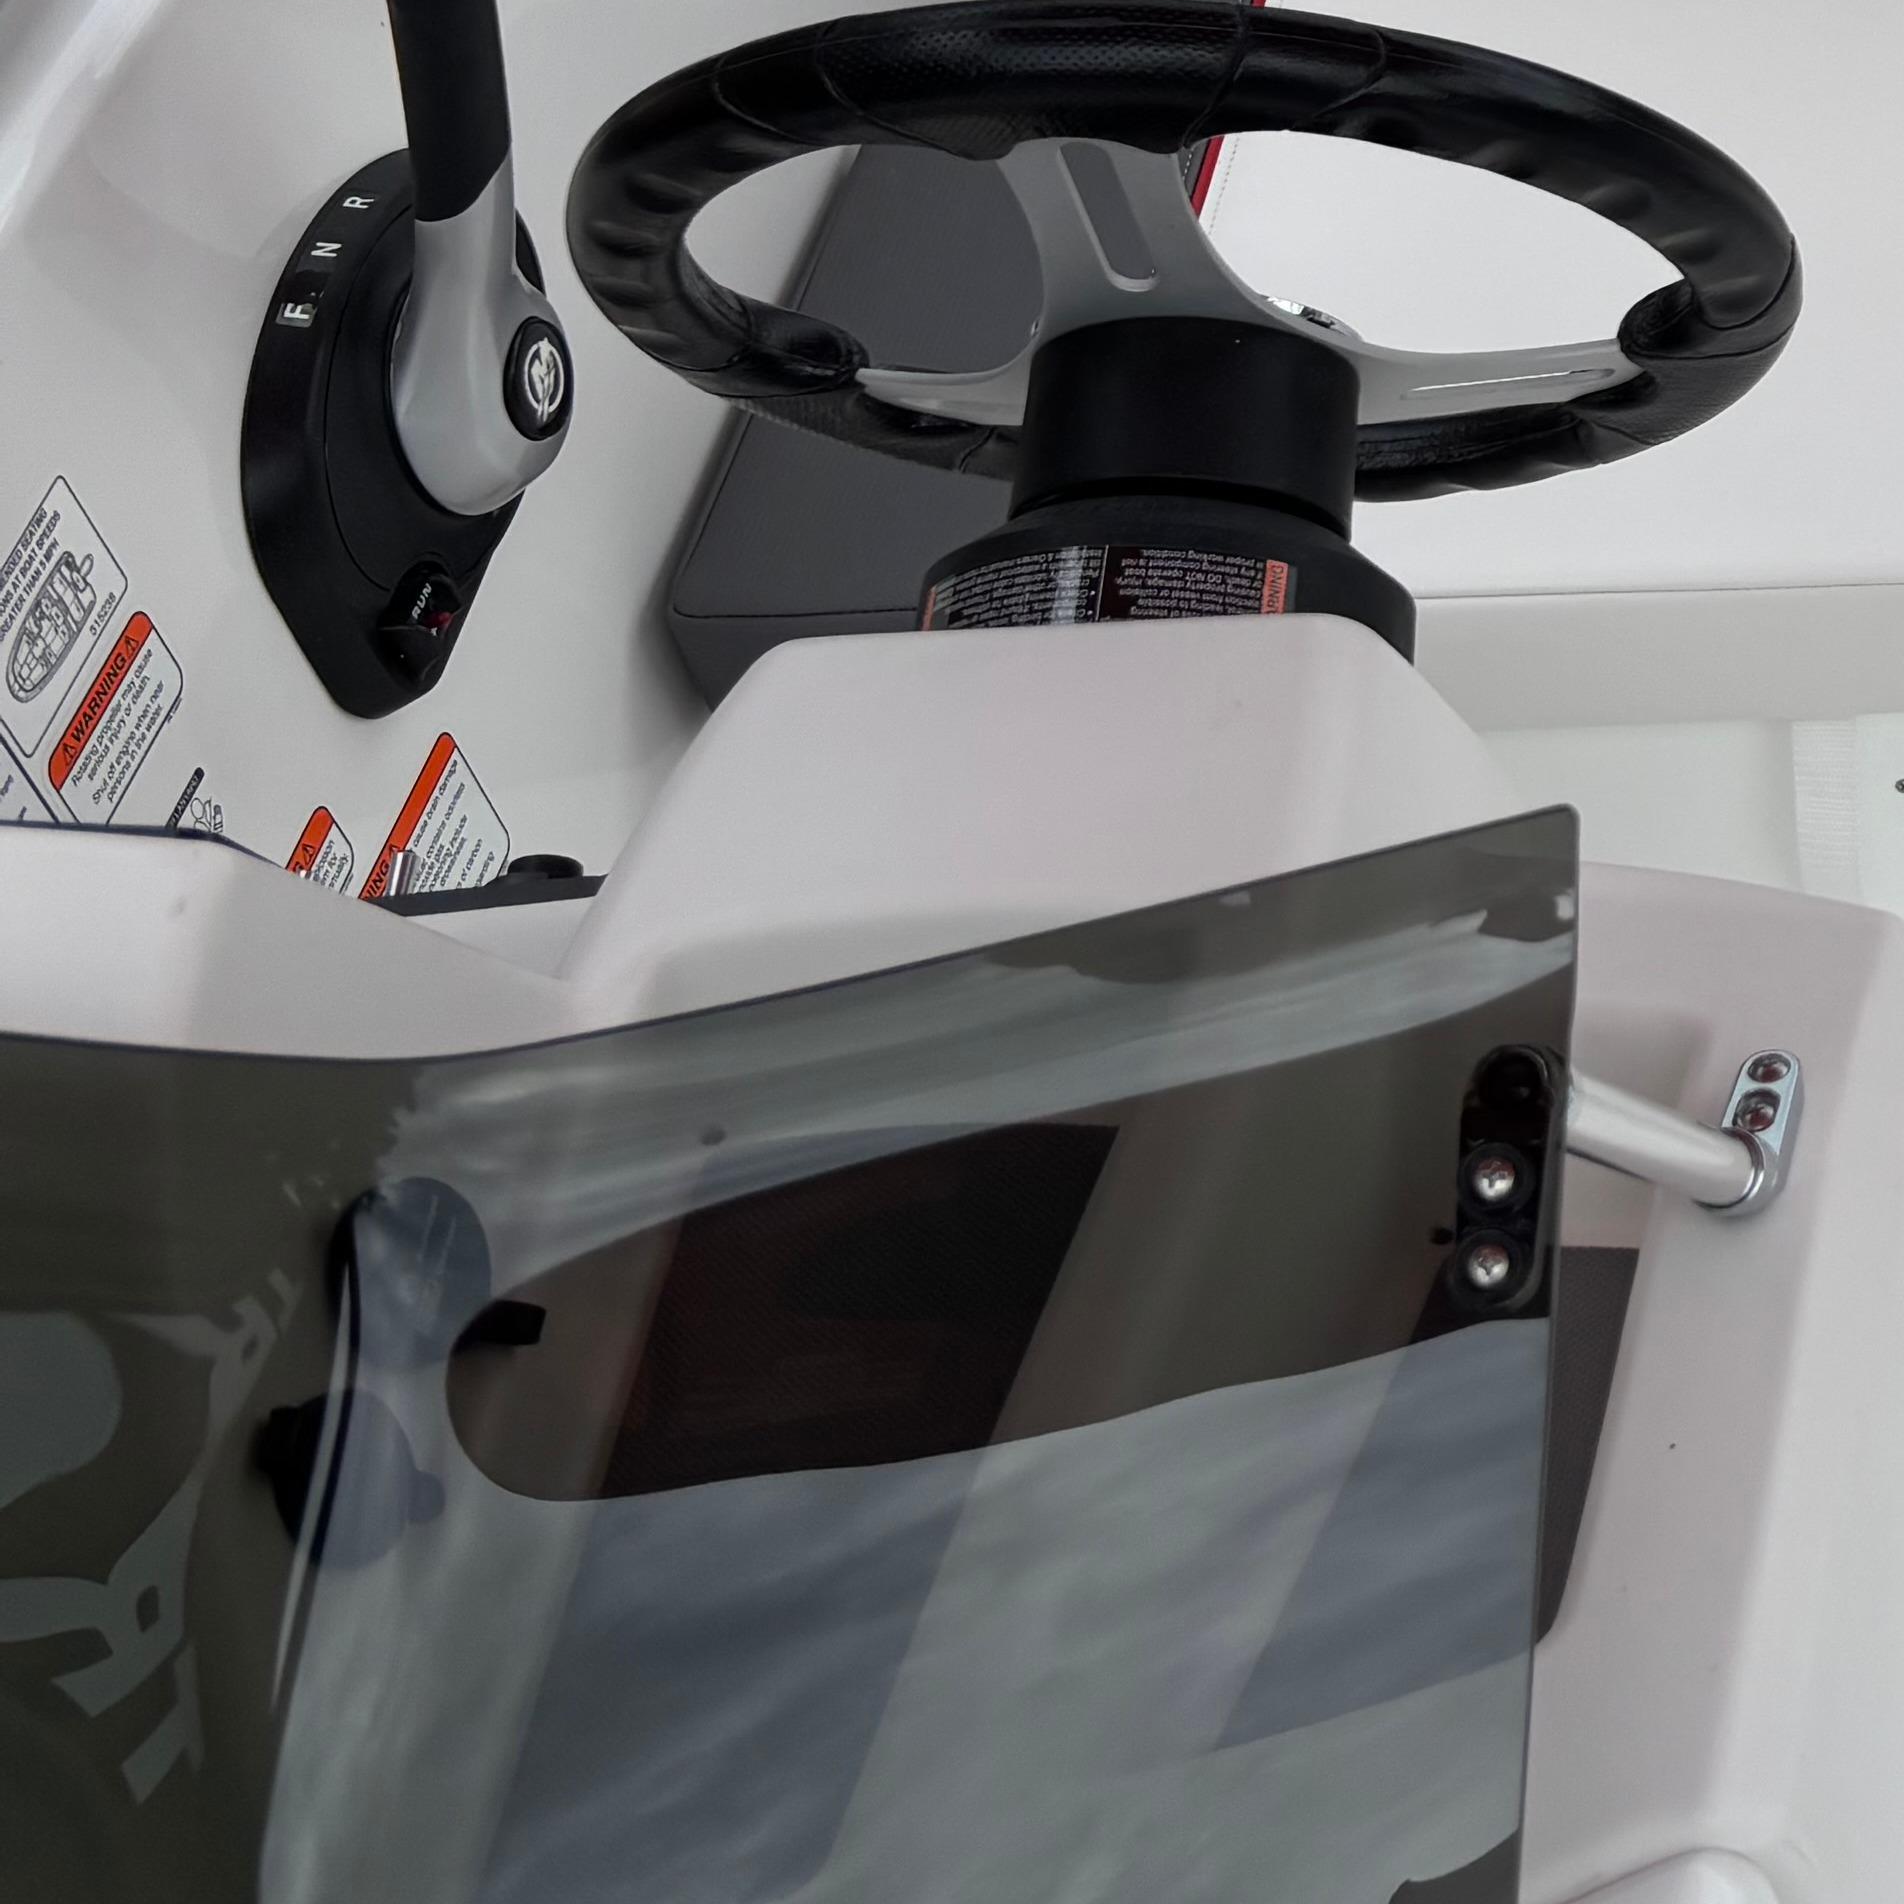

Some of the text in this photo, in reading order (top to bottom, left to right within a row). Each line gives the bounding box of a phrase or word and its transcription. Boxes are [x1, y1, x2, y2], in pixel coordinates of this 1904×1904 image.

[342, 196, 374, 209] R
[311, 242, 342, 258] N
[283, 303, 310, 320] F
[21, 507, 47, 551] SEATING
[12, 574, 21, 593] AT
[19, 548, 38, 579] BOAT
[36, 511, 60, 550] SPEEDS
[1187, 549, 1223, 562] working
[23, 567, 42, 596] THAN
[39, 560, 46, 570] 5
[43, 538, 59, 563] MPH
[1120, 557, 1137, 566] not
[1148, 558, 1200, 569] component
[1202, 561, 1238, 575] steering
[1224, 554, 1254, 567] proper
[1124, 567, 1145, 577] boat
[1147, 567, 1182, 577] operate
[1184, 571, 1205, 580] NOT
[1207, 573, 1222, 582] DO
[1240, 566, 1254, 576] any
[1185, 580, 1224, 593] property
[1227, 584, 1260, 597] causing
[412, 582, 432, 620] RUN
[71, 652, 126, 743] WARNING
[71, 649, 152, 787] Rotating propeller may cause
[88, 744, 110, 781] serious
[108, 717, 126, 745] injury
[124, 703, 131, 716] or
[92, 681, 163, 804] Shut off engine when near
[107, 760, 131, 803] persons
[127, 750, 138, 761] in
[135, 732, 146, 750] the
[413, 760, 457, 847] cause brain damage
[449, 815, 467, 848] include
[466, 839, 482, 870] carbon
[363, 861, 388, 899] NING
